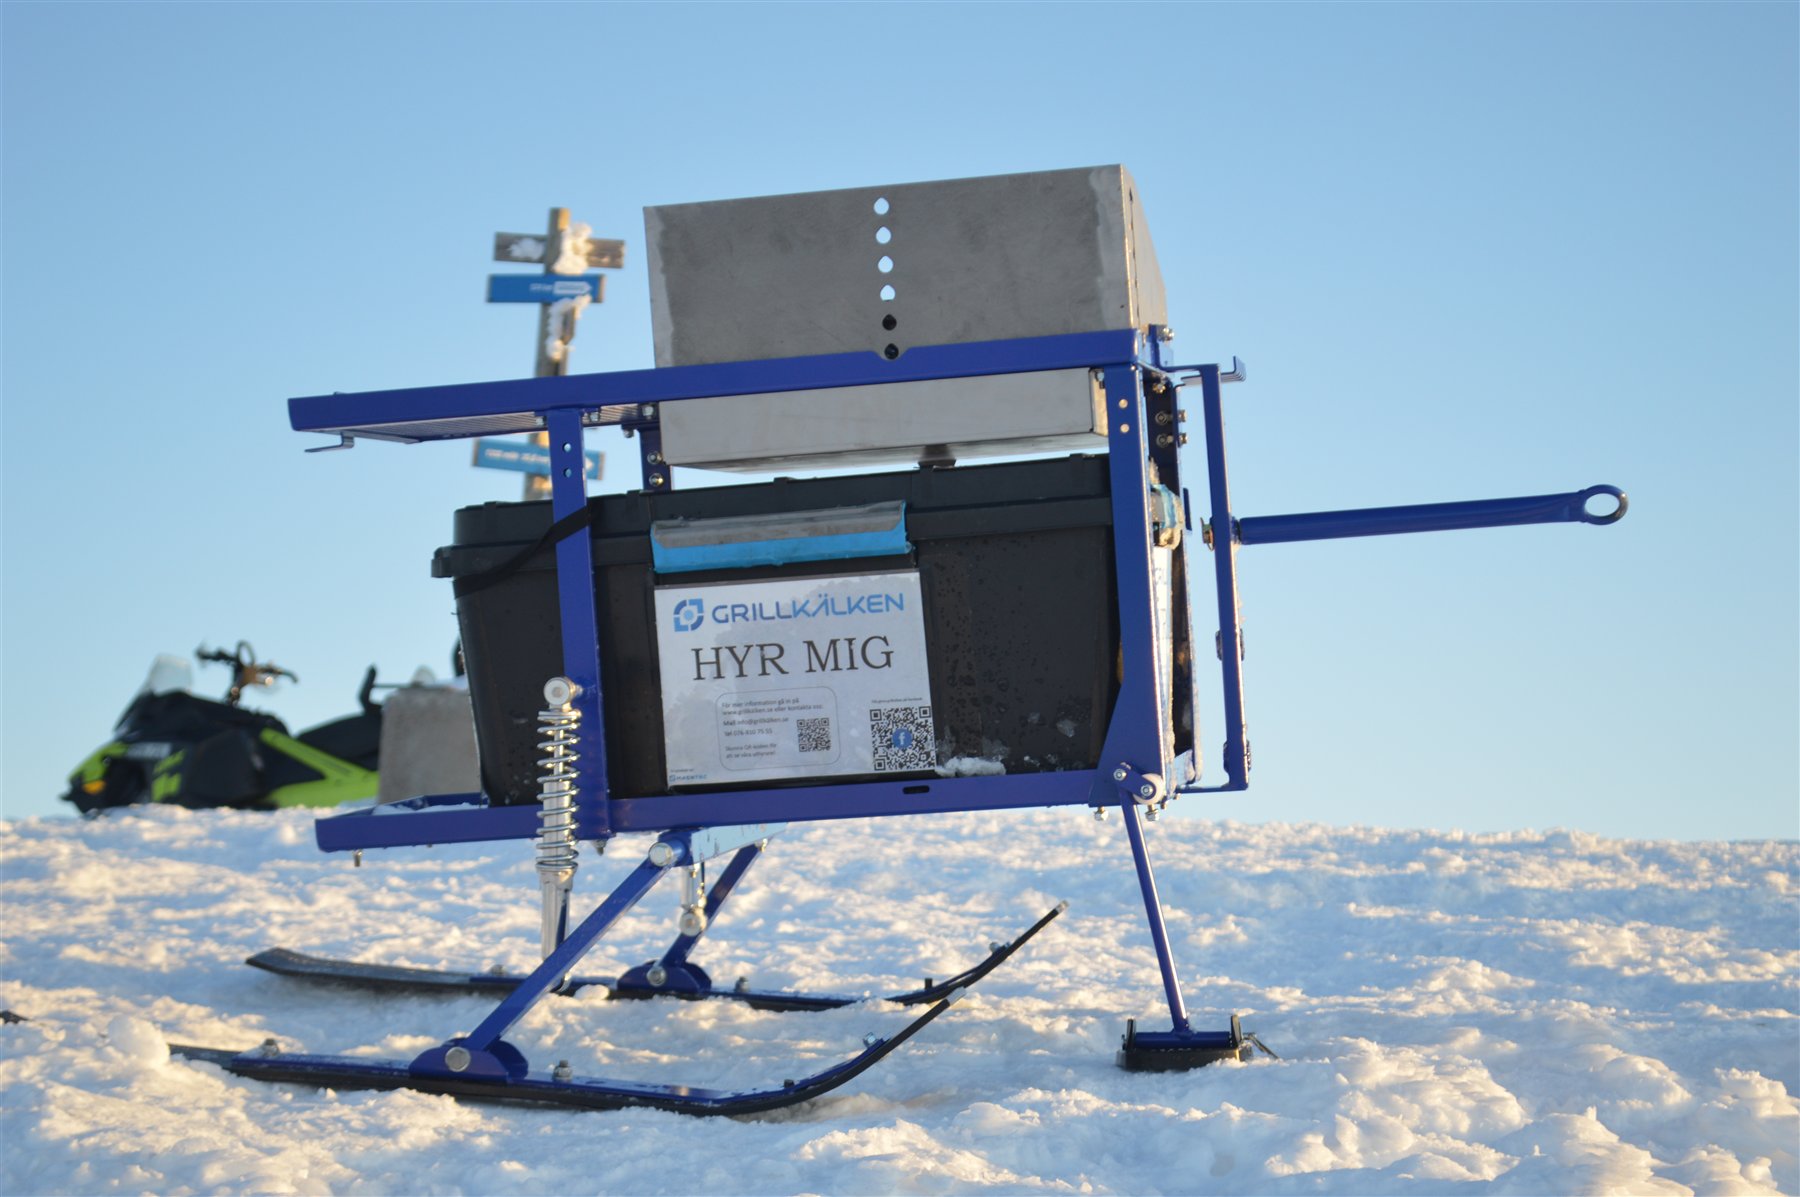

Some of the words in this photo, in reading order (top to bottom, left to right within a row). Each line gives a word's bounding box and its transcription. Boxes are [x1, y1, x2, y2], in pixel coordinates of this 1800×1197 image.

[712, 593, 904, 624] GRILLKÄLKEN
[691, 643, 789, 680] HYR
[802, 636, 894, 674] MIG
[744, 698, 777, 707] information
